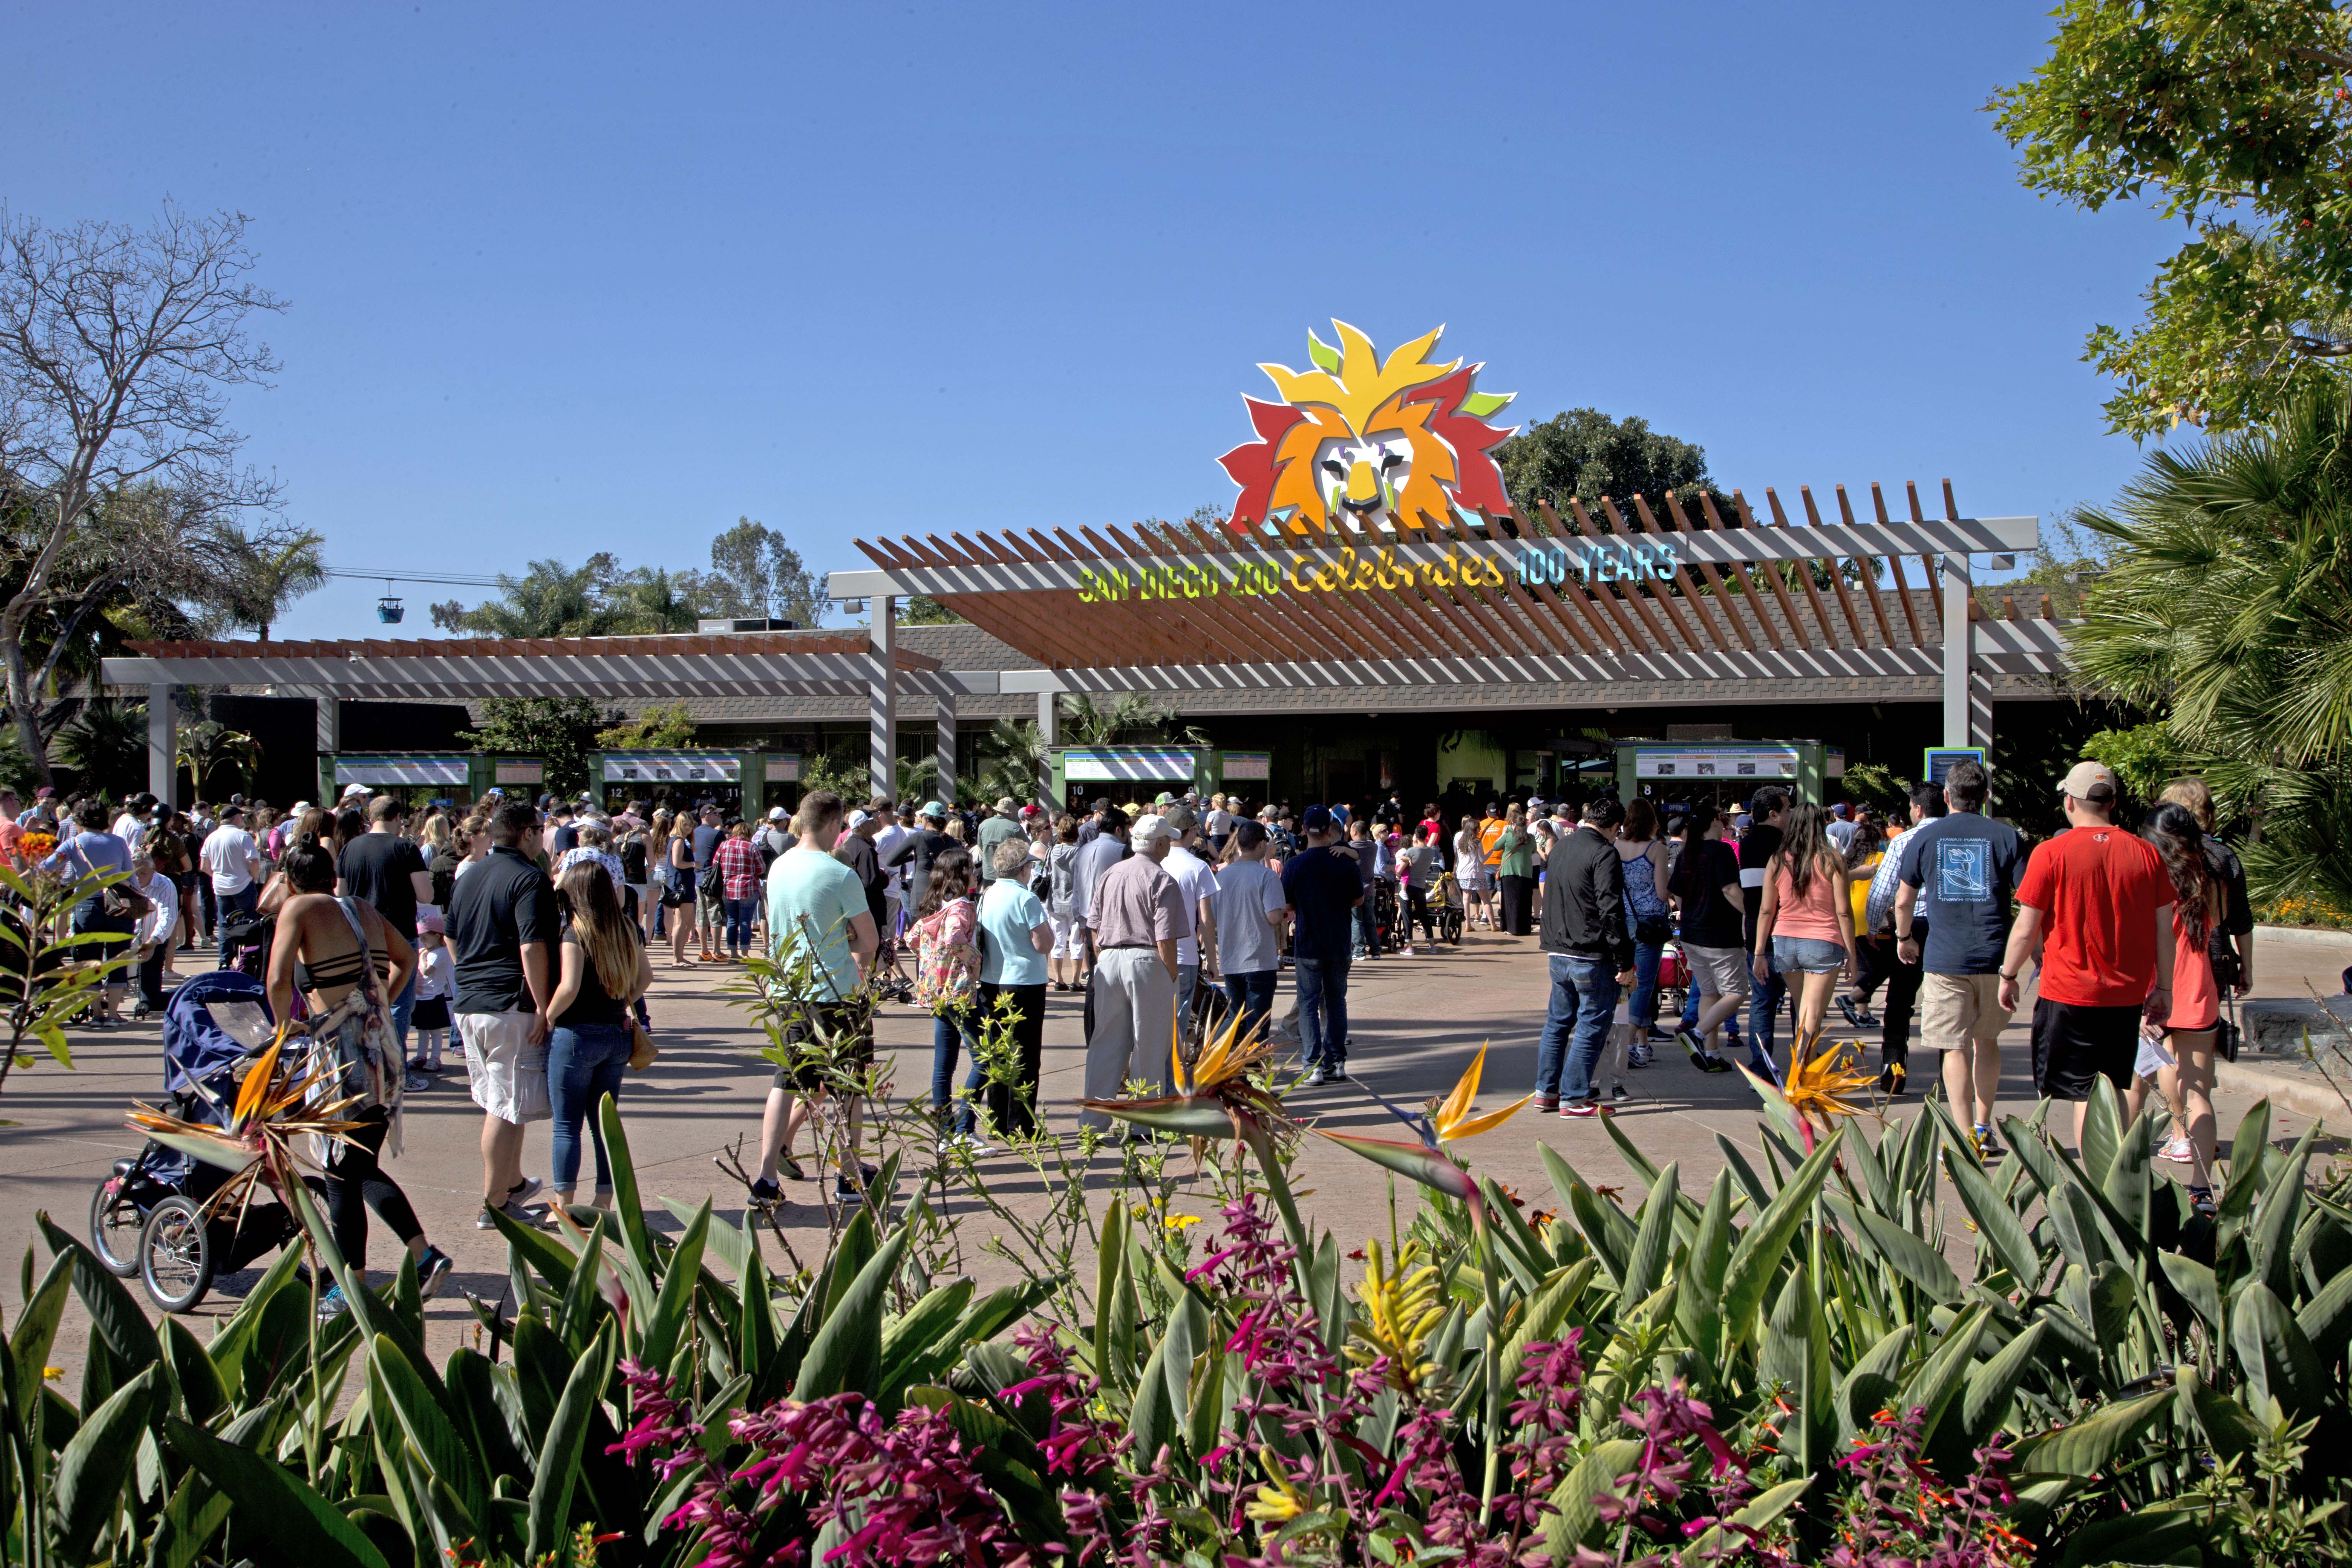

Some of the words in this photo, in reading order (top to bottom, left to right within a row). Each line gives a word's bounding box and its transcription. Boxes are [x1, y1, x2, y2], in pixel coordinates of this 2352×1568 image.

[1078, 568, 1129, 603] SAN
[1141, 564, 1218, 600] DIEGO
[1229, 560, 1280, 596] ZOO
[1290, 543, 1504, 592] Celebrates
[1515, 547, 1565, 585] 100
[1577, 543, 1677, 582] YEARS
[611, 788, 622, 797] 12
[728, 788, 738, 797] 11
[1072, 786, 1083, 795] 10
[1644, 785, 1651, 795] 8
[1787, 786, 1793, 795] 7
